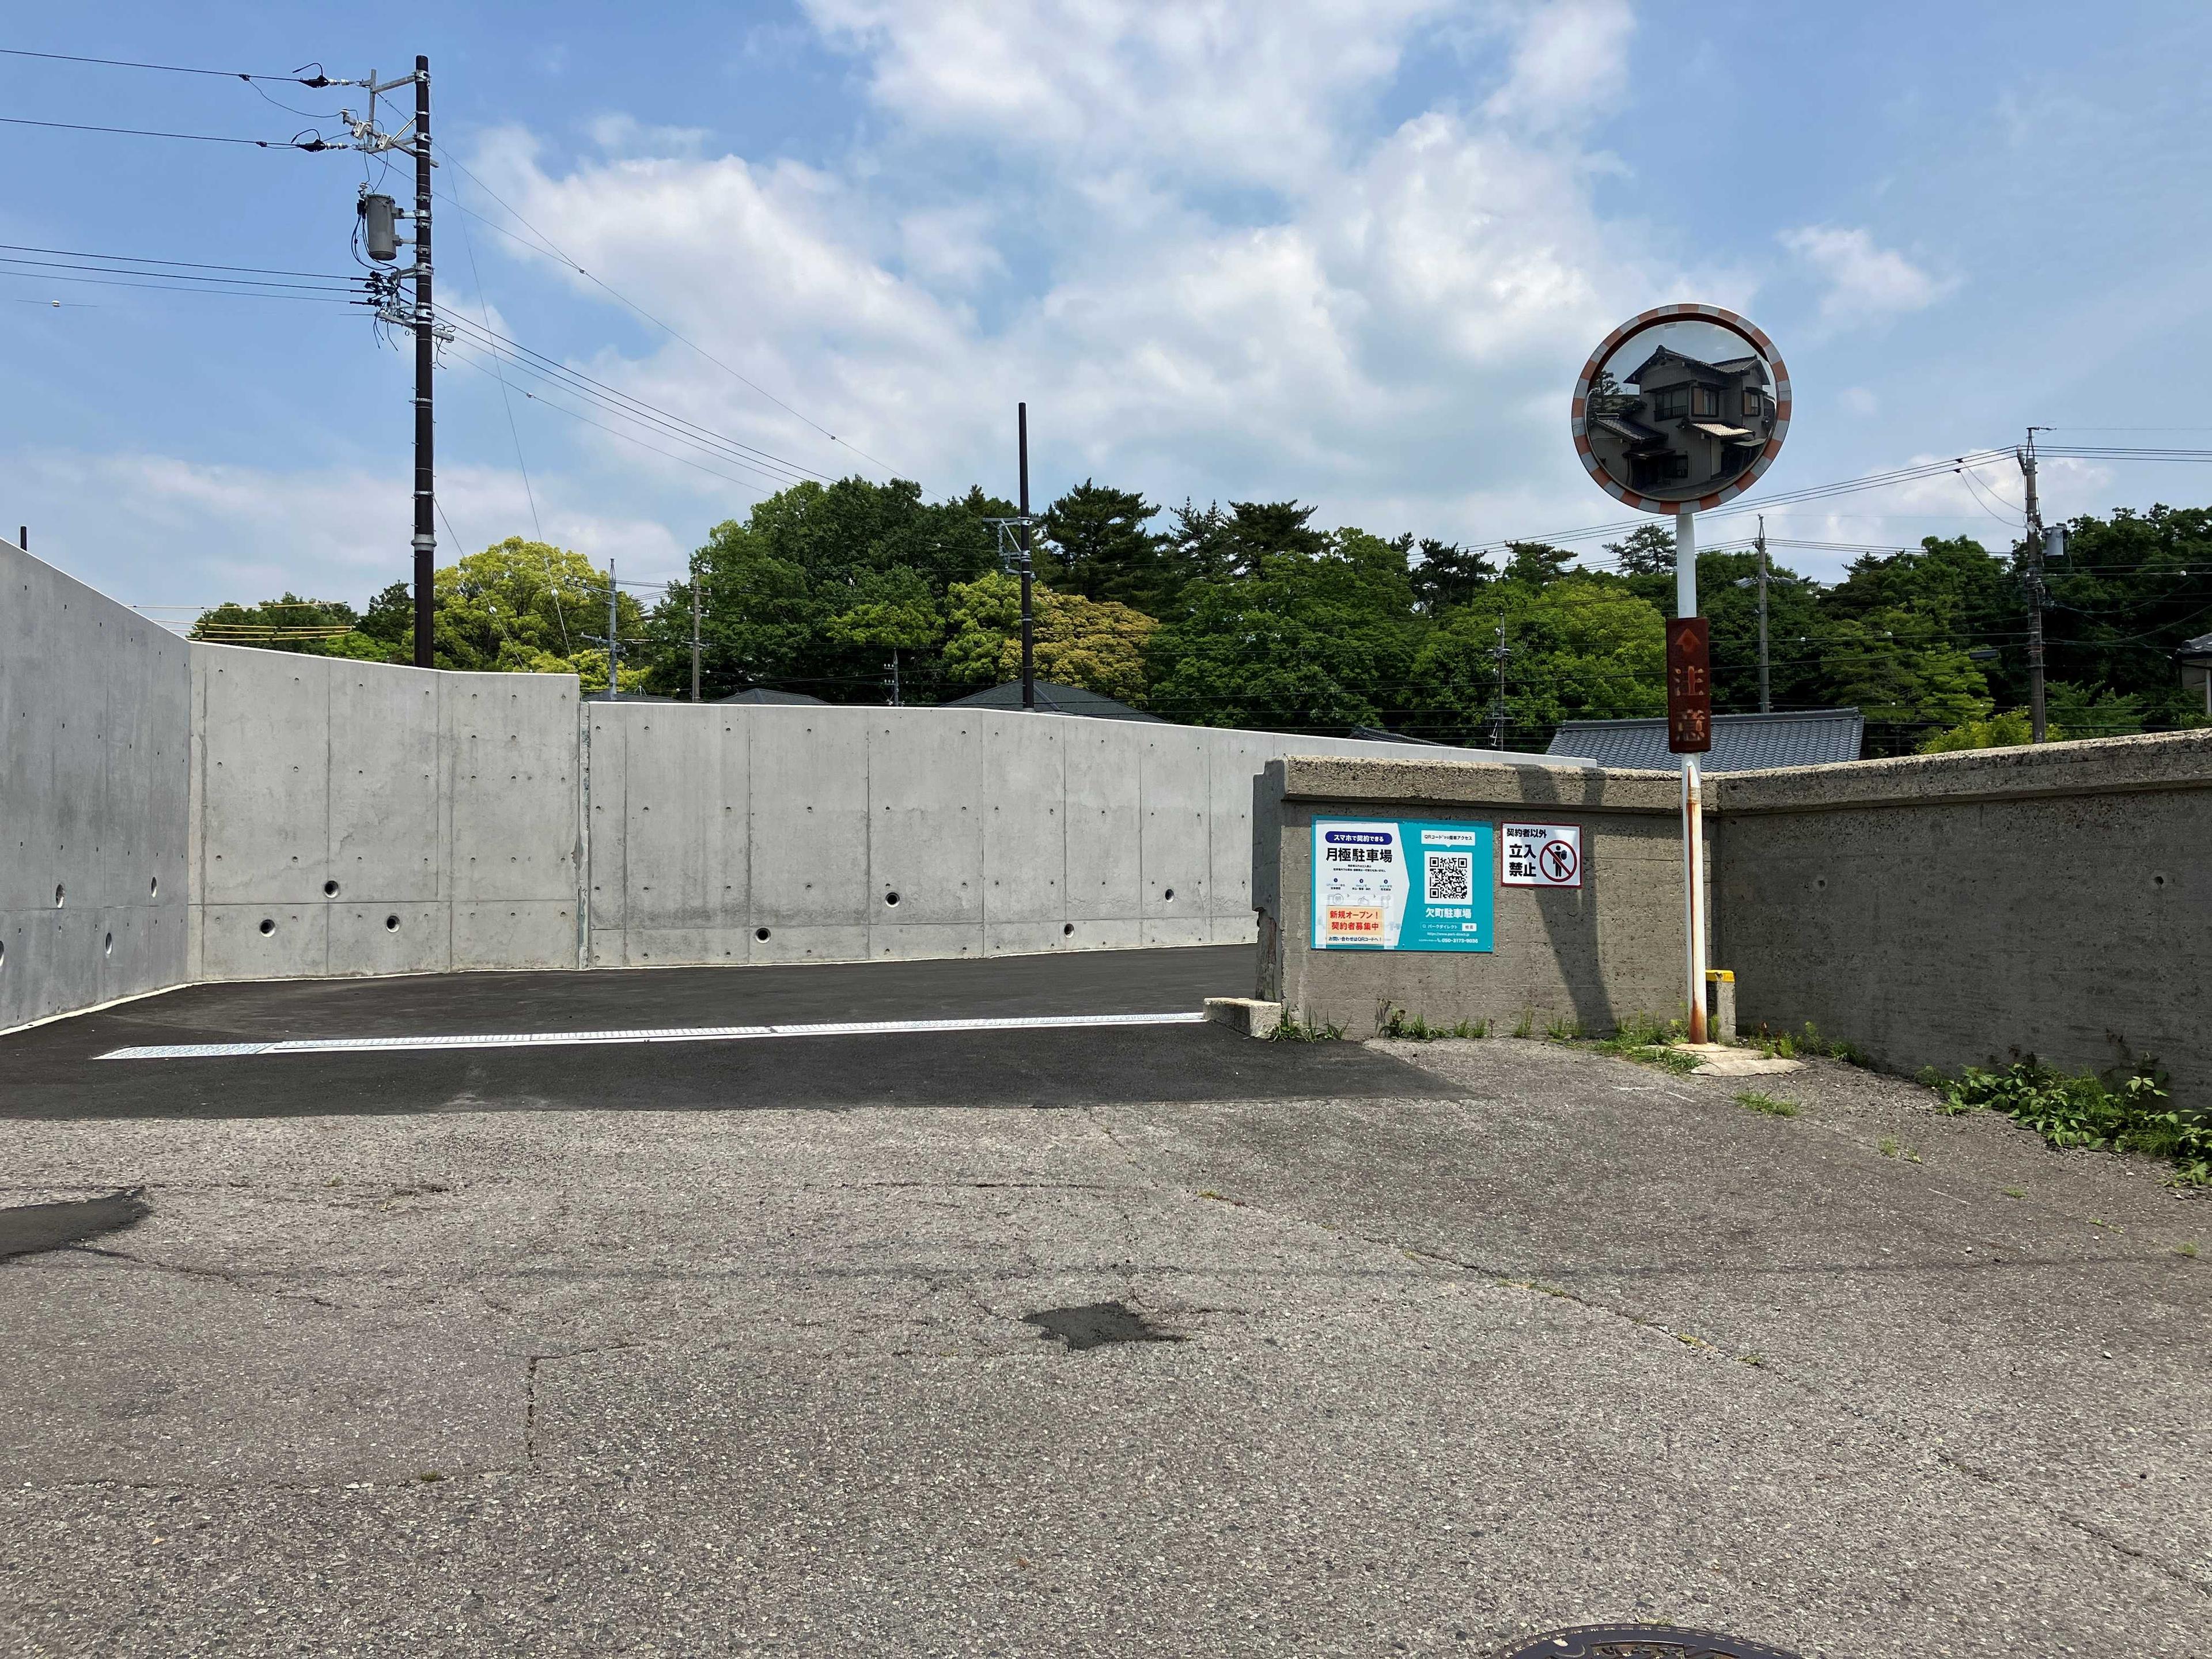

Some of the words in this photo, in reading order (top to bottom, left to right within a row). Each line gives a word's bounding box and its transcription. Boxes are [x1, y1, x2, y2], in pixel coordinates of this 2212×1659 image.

[1334, 834, 1384, 842] スマホで契約できる
[1506, 828, 1547, 838] 契約者以外
[1326, 847, 1392, 863] 月極駐車場
[1509, 843, 1536, 859] 立入
[1509, 862, 1536, 877] 禁止
[1330, 910, 1378, 919] 新規オープン！
[1425, 907, 1472, 919] 欠町駐車場
[1331, 922, 1378, 931] 契約者募集中
